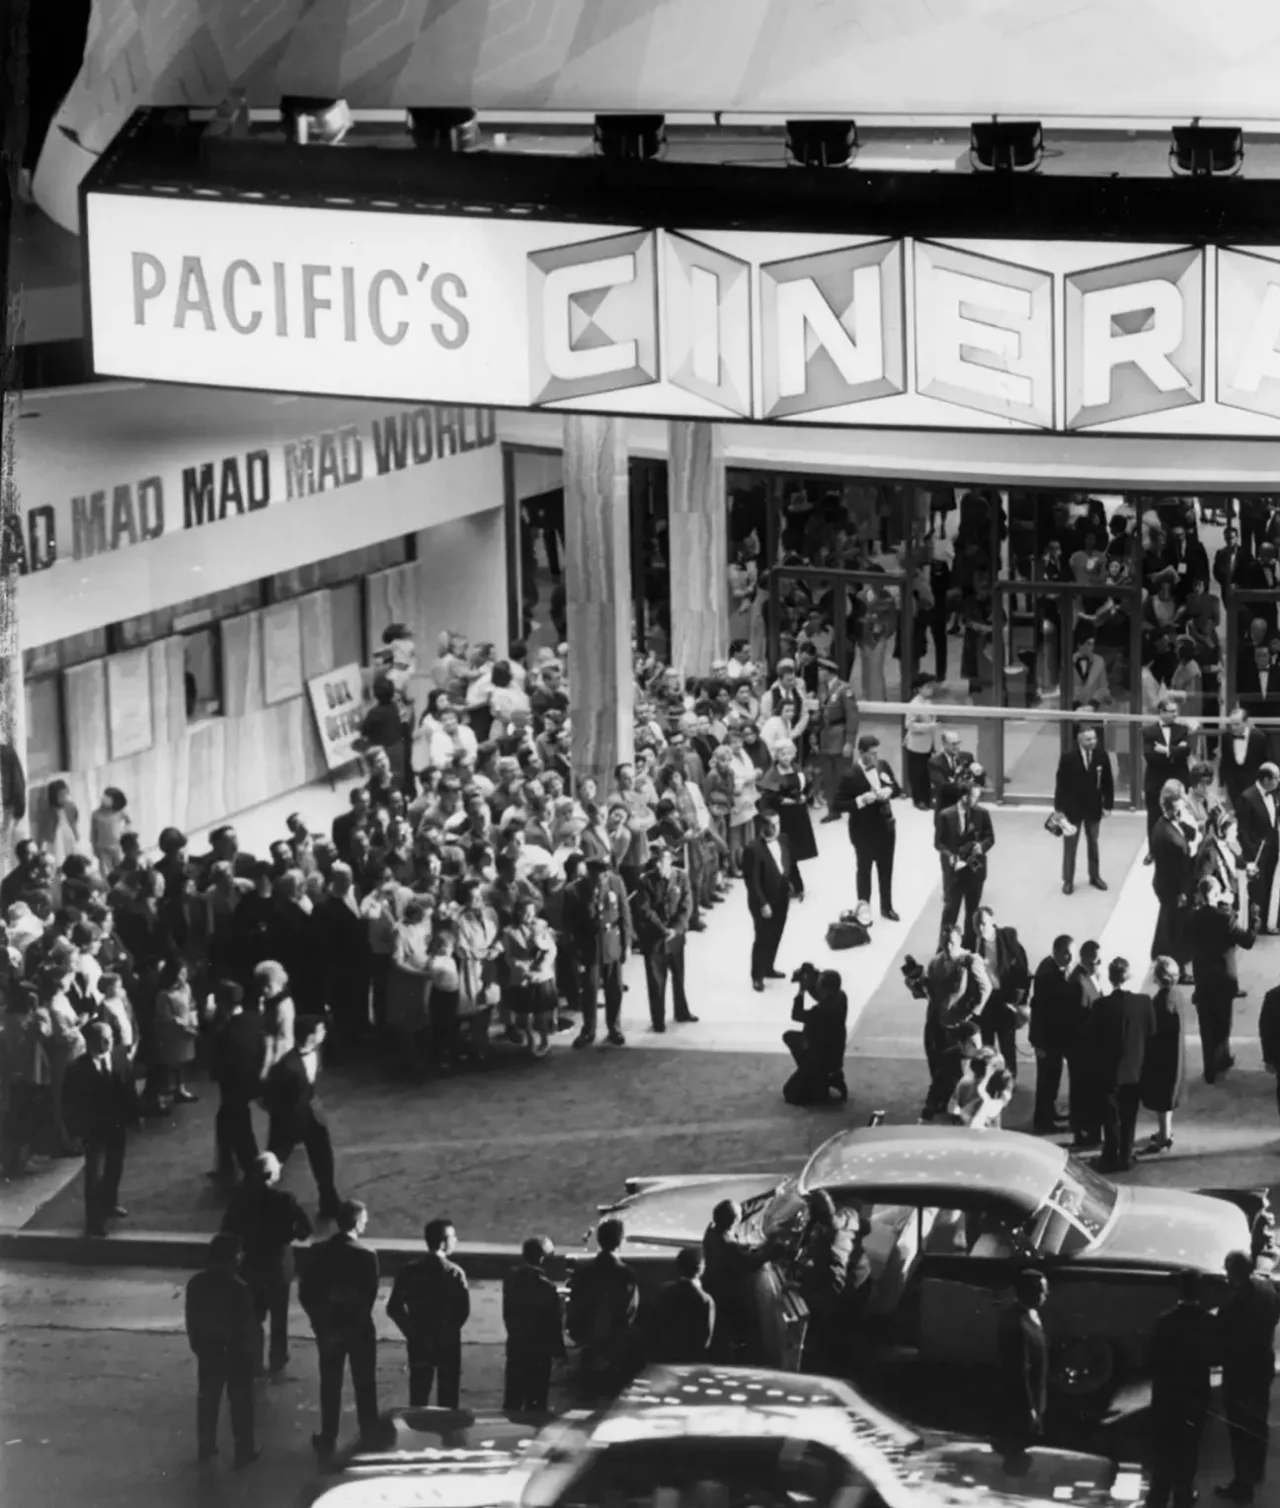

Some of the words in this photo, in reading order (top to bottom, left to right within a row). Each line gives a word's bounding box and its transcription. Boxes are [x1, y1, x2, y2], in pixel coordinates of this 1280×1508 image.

[131, 251, 469, 350] PACIFIC'S
[0, 505, 57, 577] AD
[71, 475, 165, 561] MAD
[182, 448, 270, 530] MAD
[284, 424, 364, 500] MAD
[372, 405, 497, 476] WORLD
